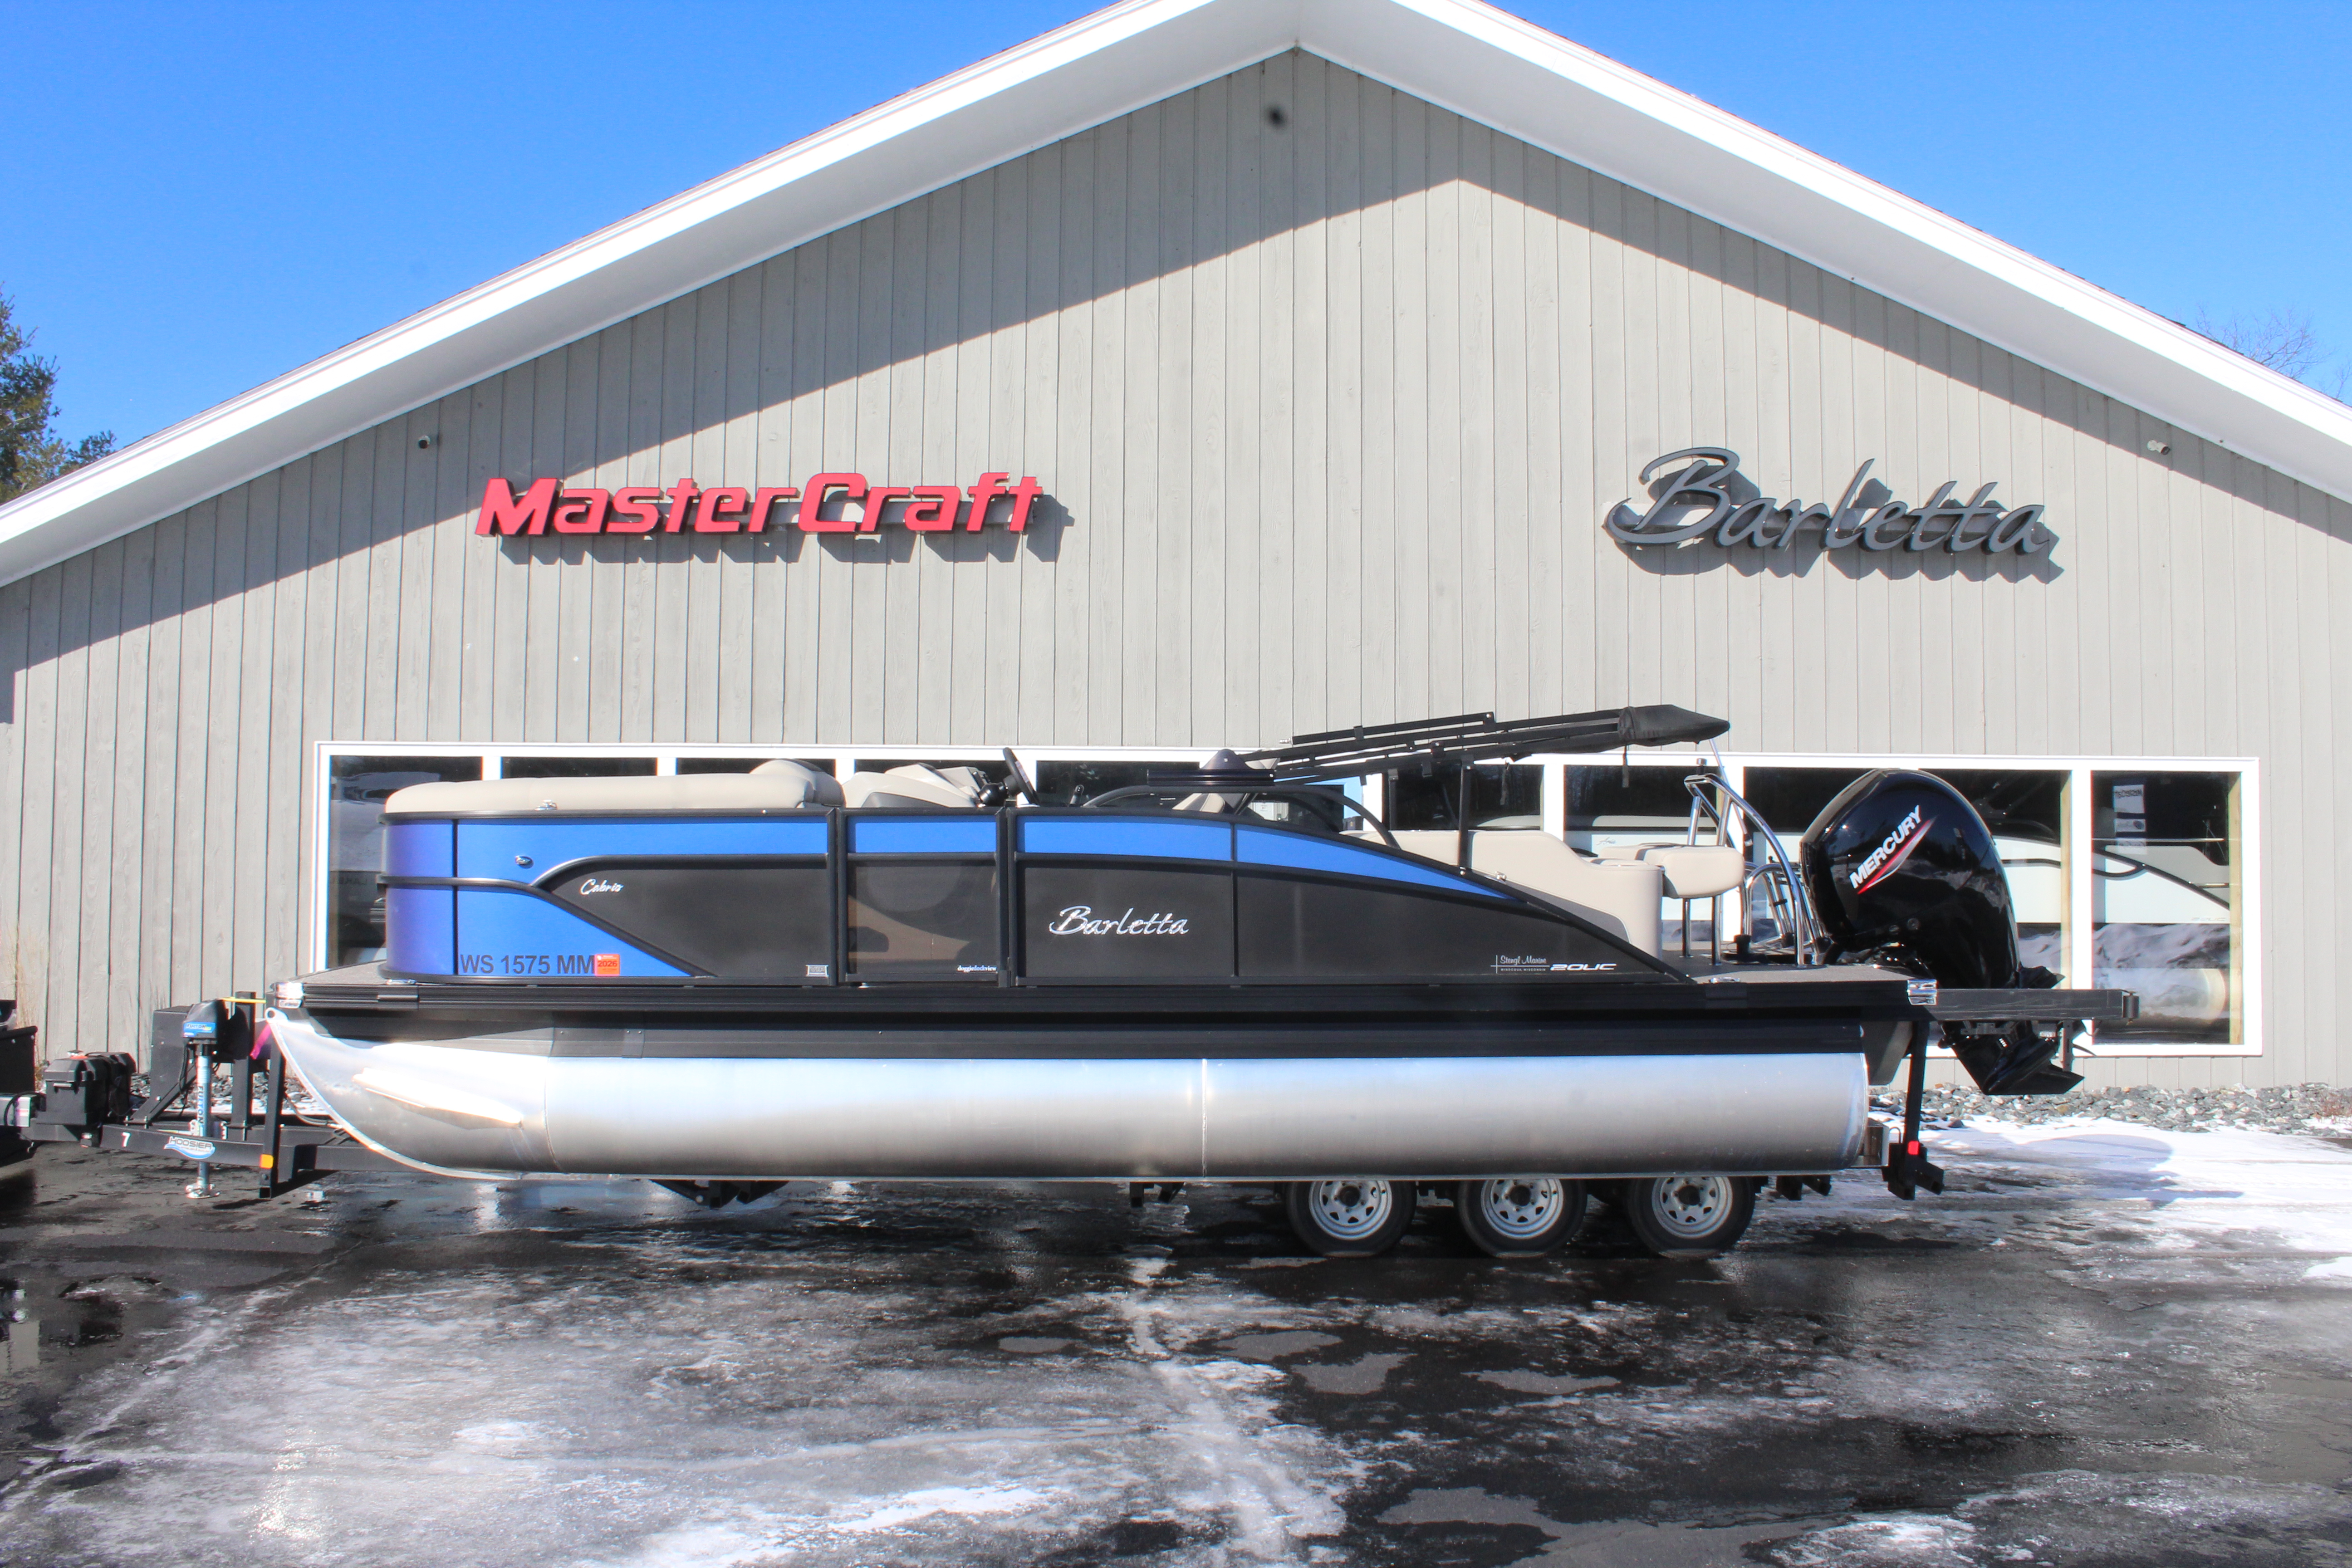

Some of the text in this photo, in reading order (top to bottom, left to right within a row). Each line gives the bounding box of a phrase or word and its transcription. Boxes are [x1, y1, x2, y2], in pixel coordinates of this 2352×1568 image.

[475, 472, 1044, 535] MasterCraft
[1602, 446, 2049, 554] Barletta
[1849, 805, 1921, 889] MERCURY
[579, 878, 624, 895] Cabrio
[1049, 905, 1189, 935] Barletta
[460, 954, 595, 974] WS 1575 MM
[1522, 955, 1547, 964] Marine
[122, 1132, 131, 1147] 7
[169, 1137, 212, 1150] HOOSIER
